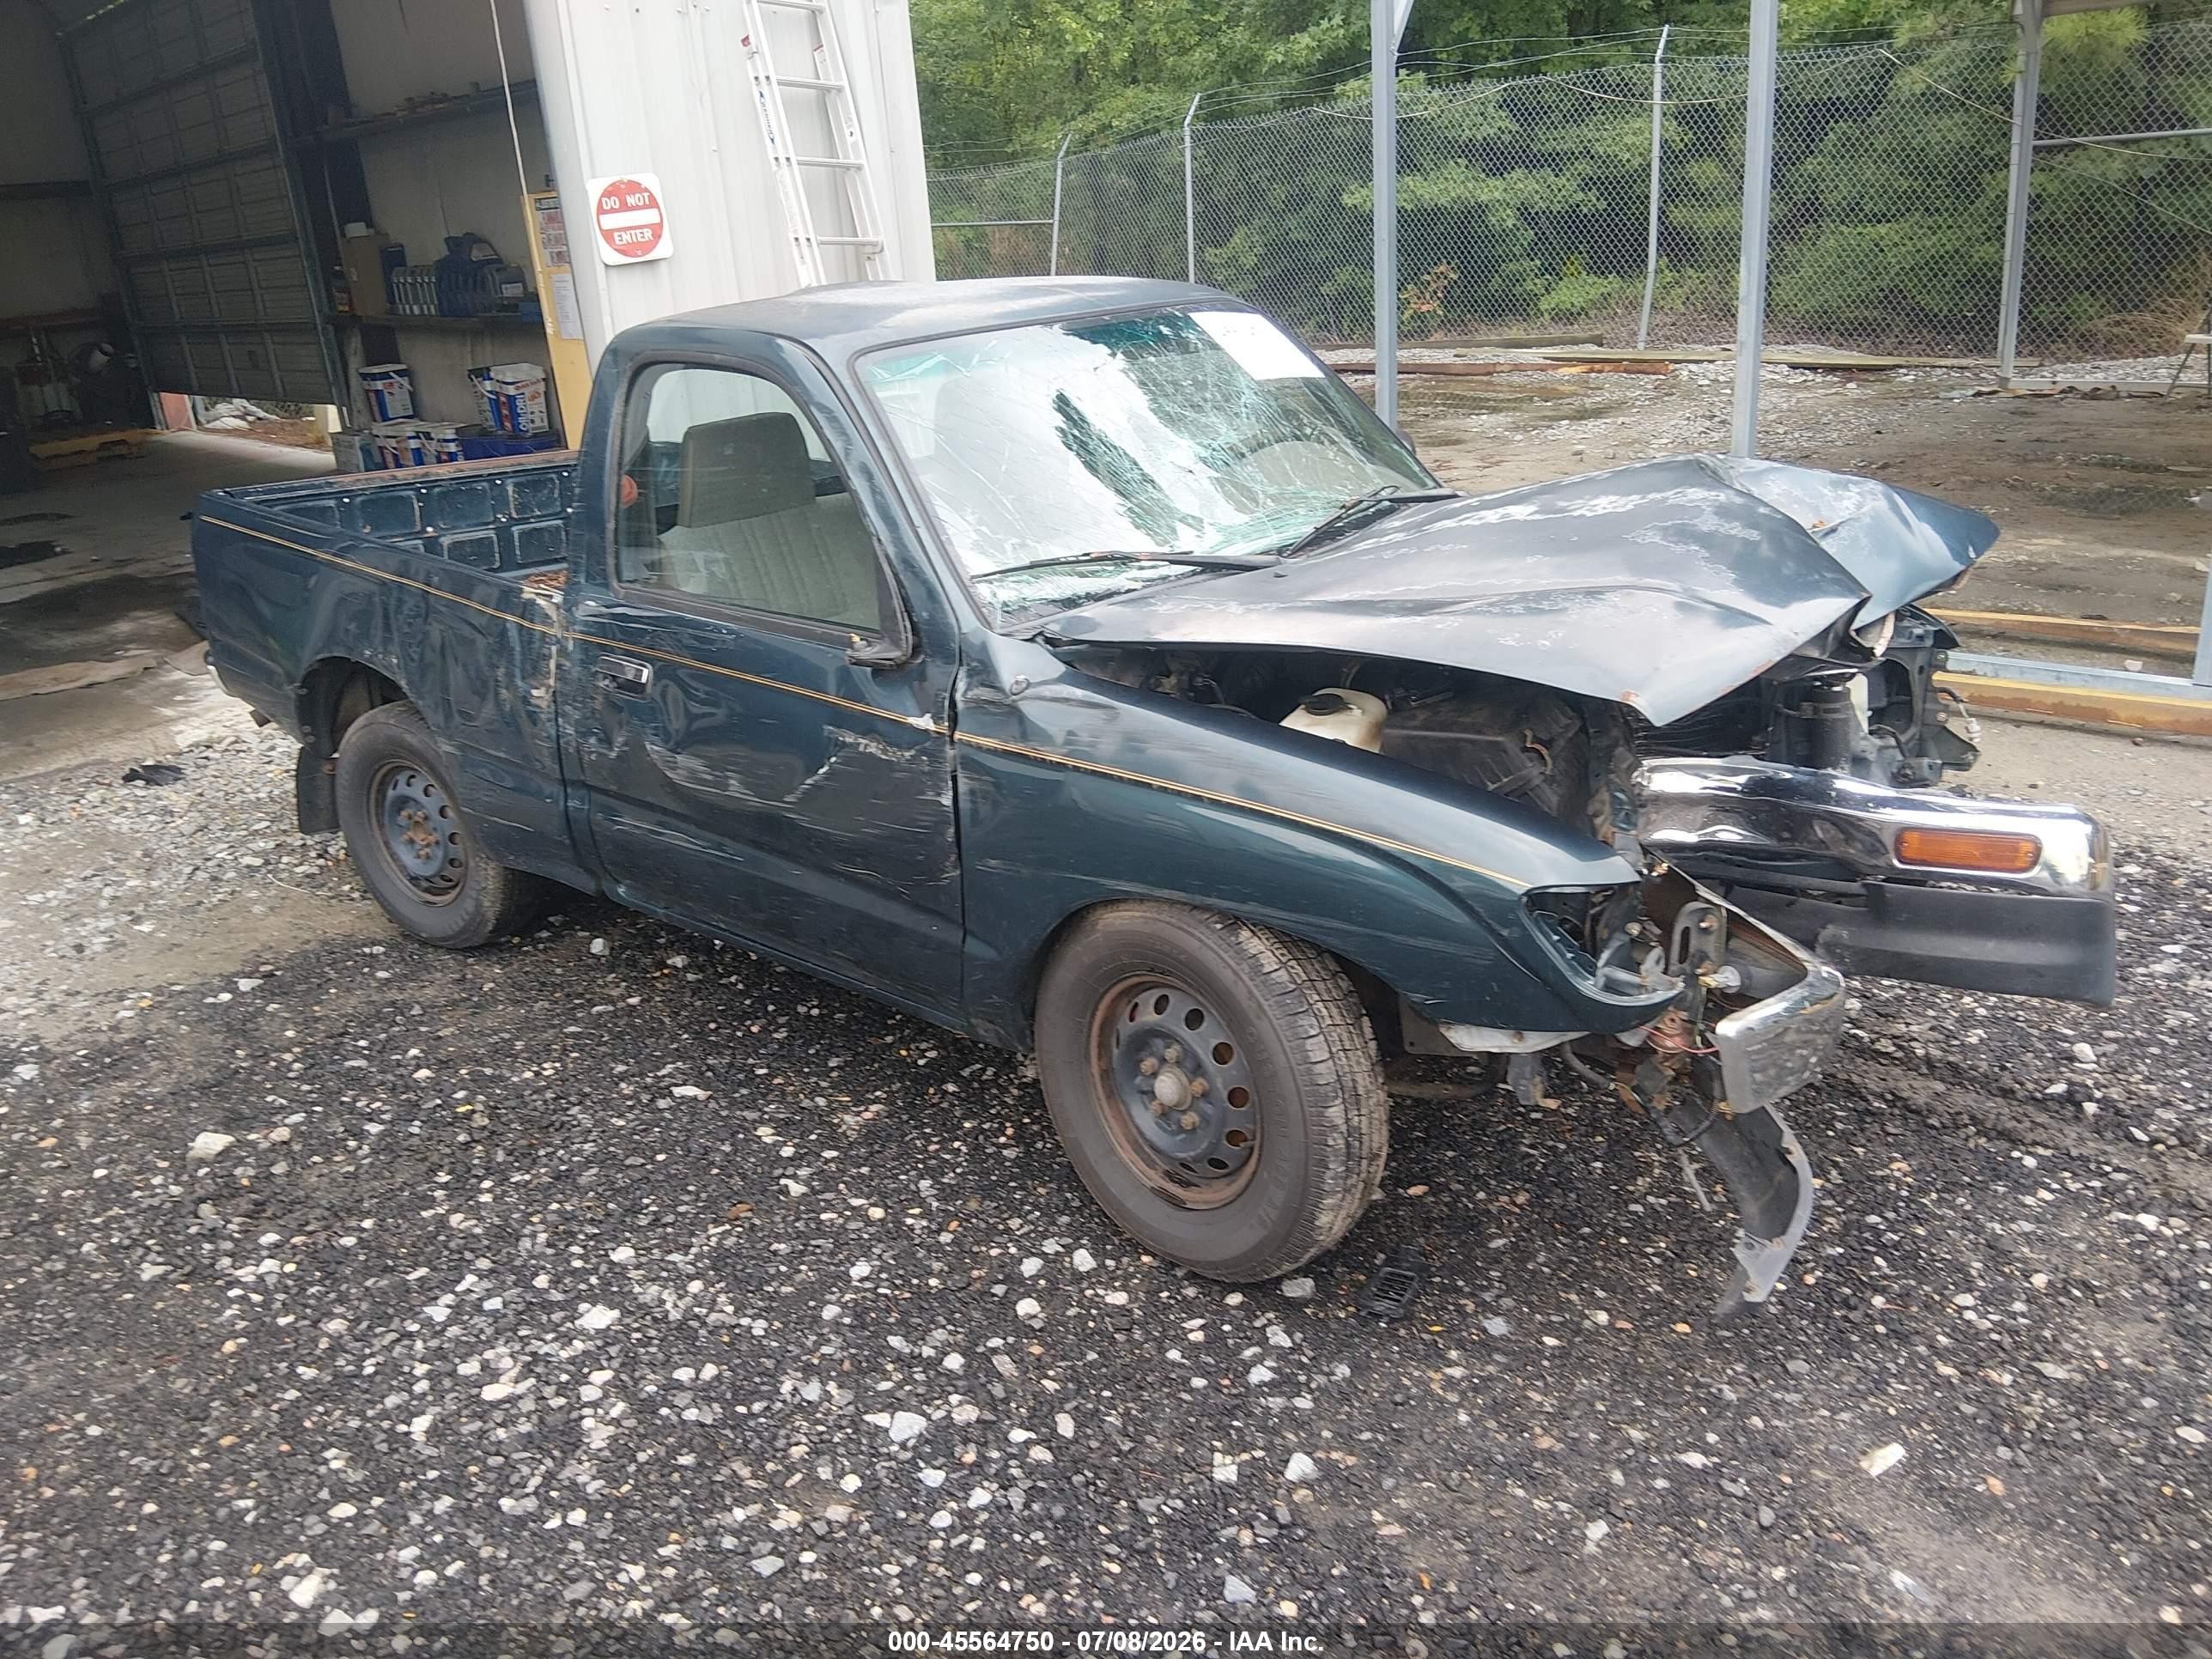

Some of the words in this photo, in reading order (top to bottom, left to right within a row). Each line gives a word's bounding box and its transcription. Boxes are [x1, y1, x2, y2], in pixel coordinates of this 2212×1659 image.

[601, 196, 620, 210] DO
[625, 192, 651, 207] NOT
[613, 228, 653, 245] ENTER
